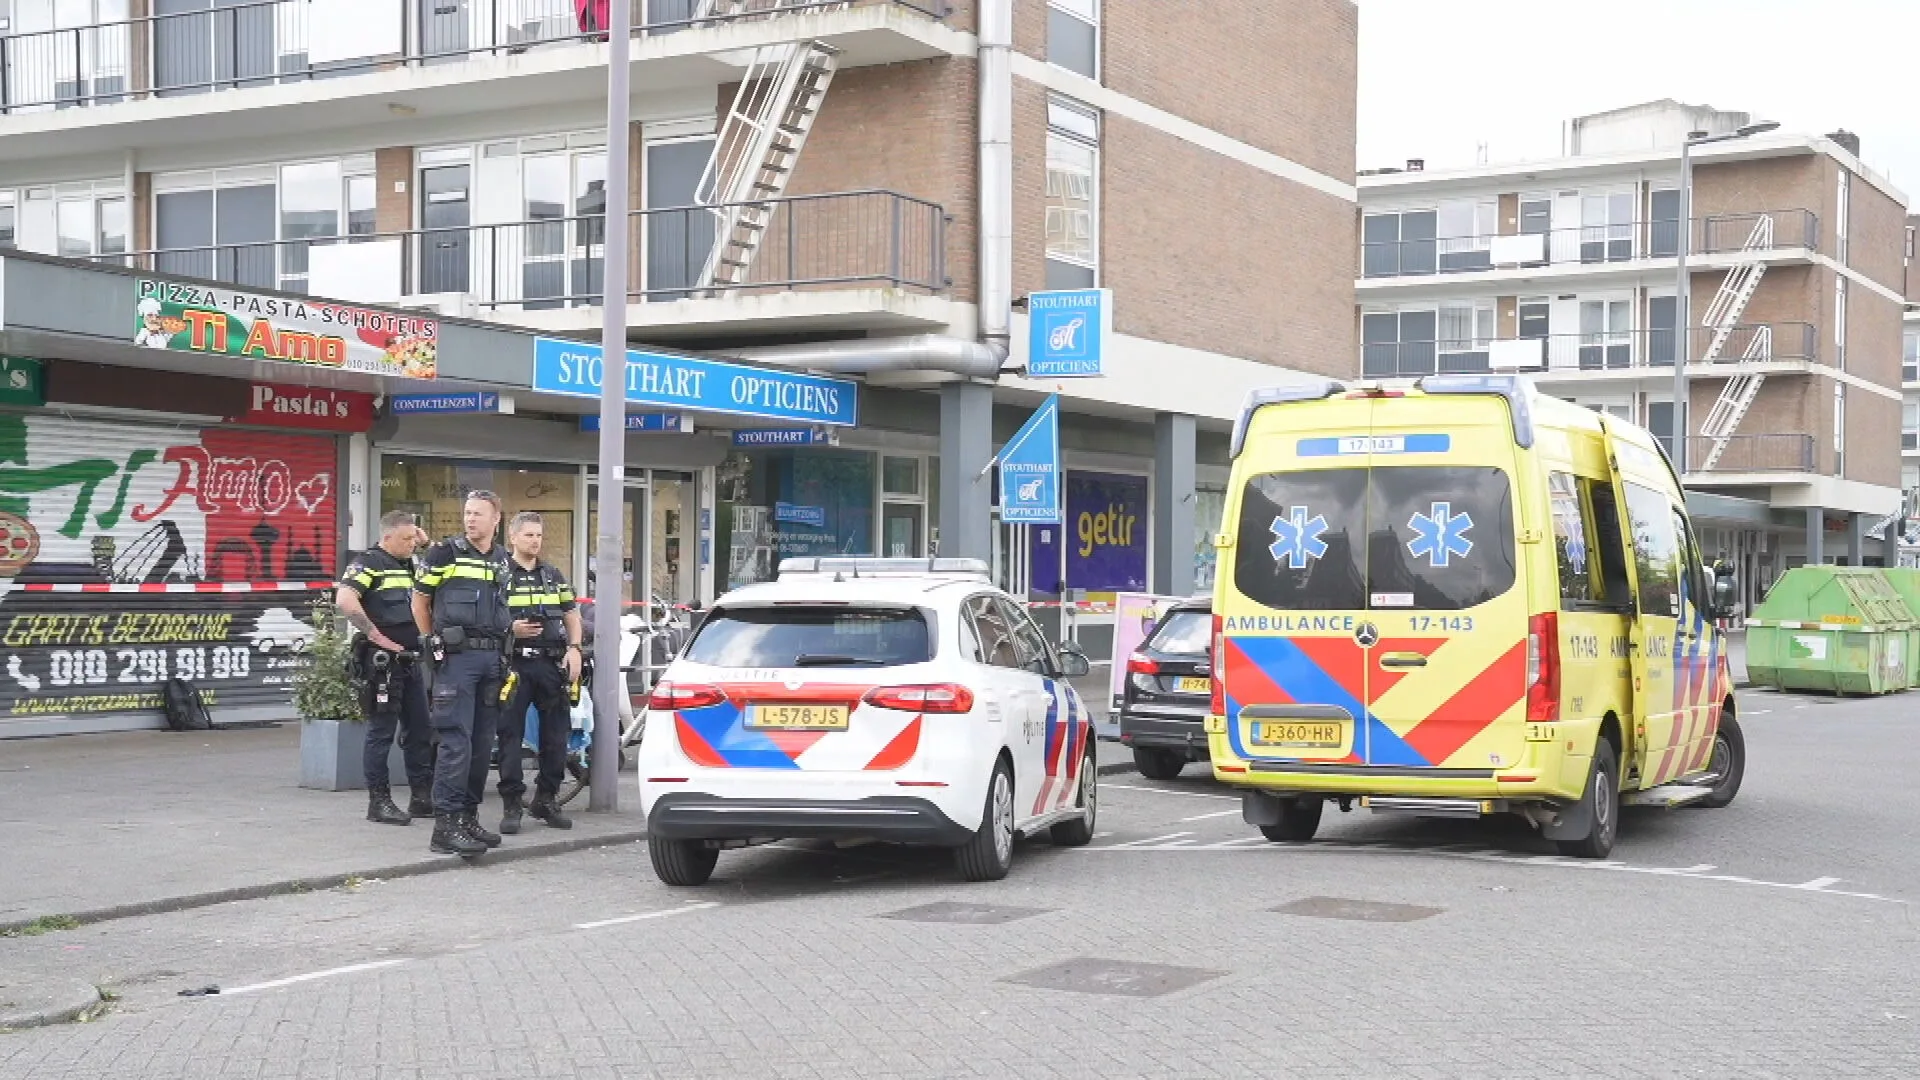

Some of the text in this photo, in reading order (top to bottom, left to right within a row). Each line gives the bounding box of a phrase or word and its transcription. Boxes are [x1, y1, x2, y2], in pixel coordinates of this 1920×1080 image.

[1031, 294, 1098, 308] STOUTHART
[182, 308, 348, 368] Ti Amo
[1031, 359, 1099, 374] OPTICIENS
[558, 351, 839, 416] STOTHART OPTICIENS
[251, 385, 349, 420] Pasta's
[393, 396, 476, 410] CONTACTLENZEN
[738, 430, 805, 444] STOUTHART
[1348, 438, 1395, 451] 17-143
[1004, 463, 1053, 473] STOUTHART
[1005, 507, 1056, 517] OPTICIENS
[1077, 502, 1136, 558] getir
[1225, 615, 1474, 632] AMBULANCE 17-143
[1570, 635, 1598, 659] 17-143
[50, 646, 250, 686] 010 291 91 90
[708, 669, 780, 681] OLITIE
[762, 707, 839, 725] L-578-JS
[1264, 725, 1334, 741] J-360-HR
